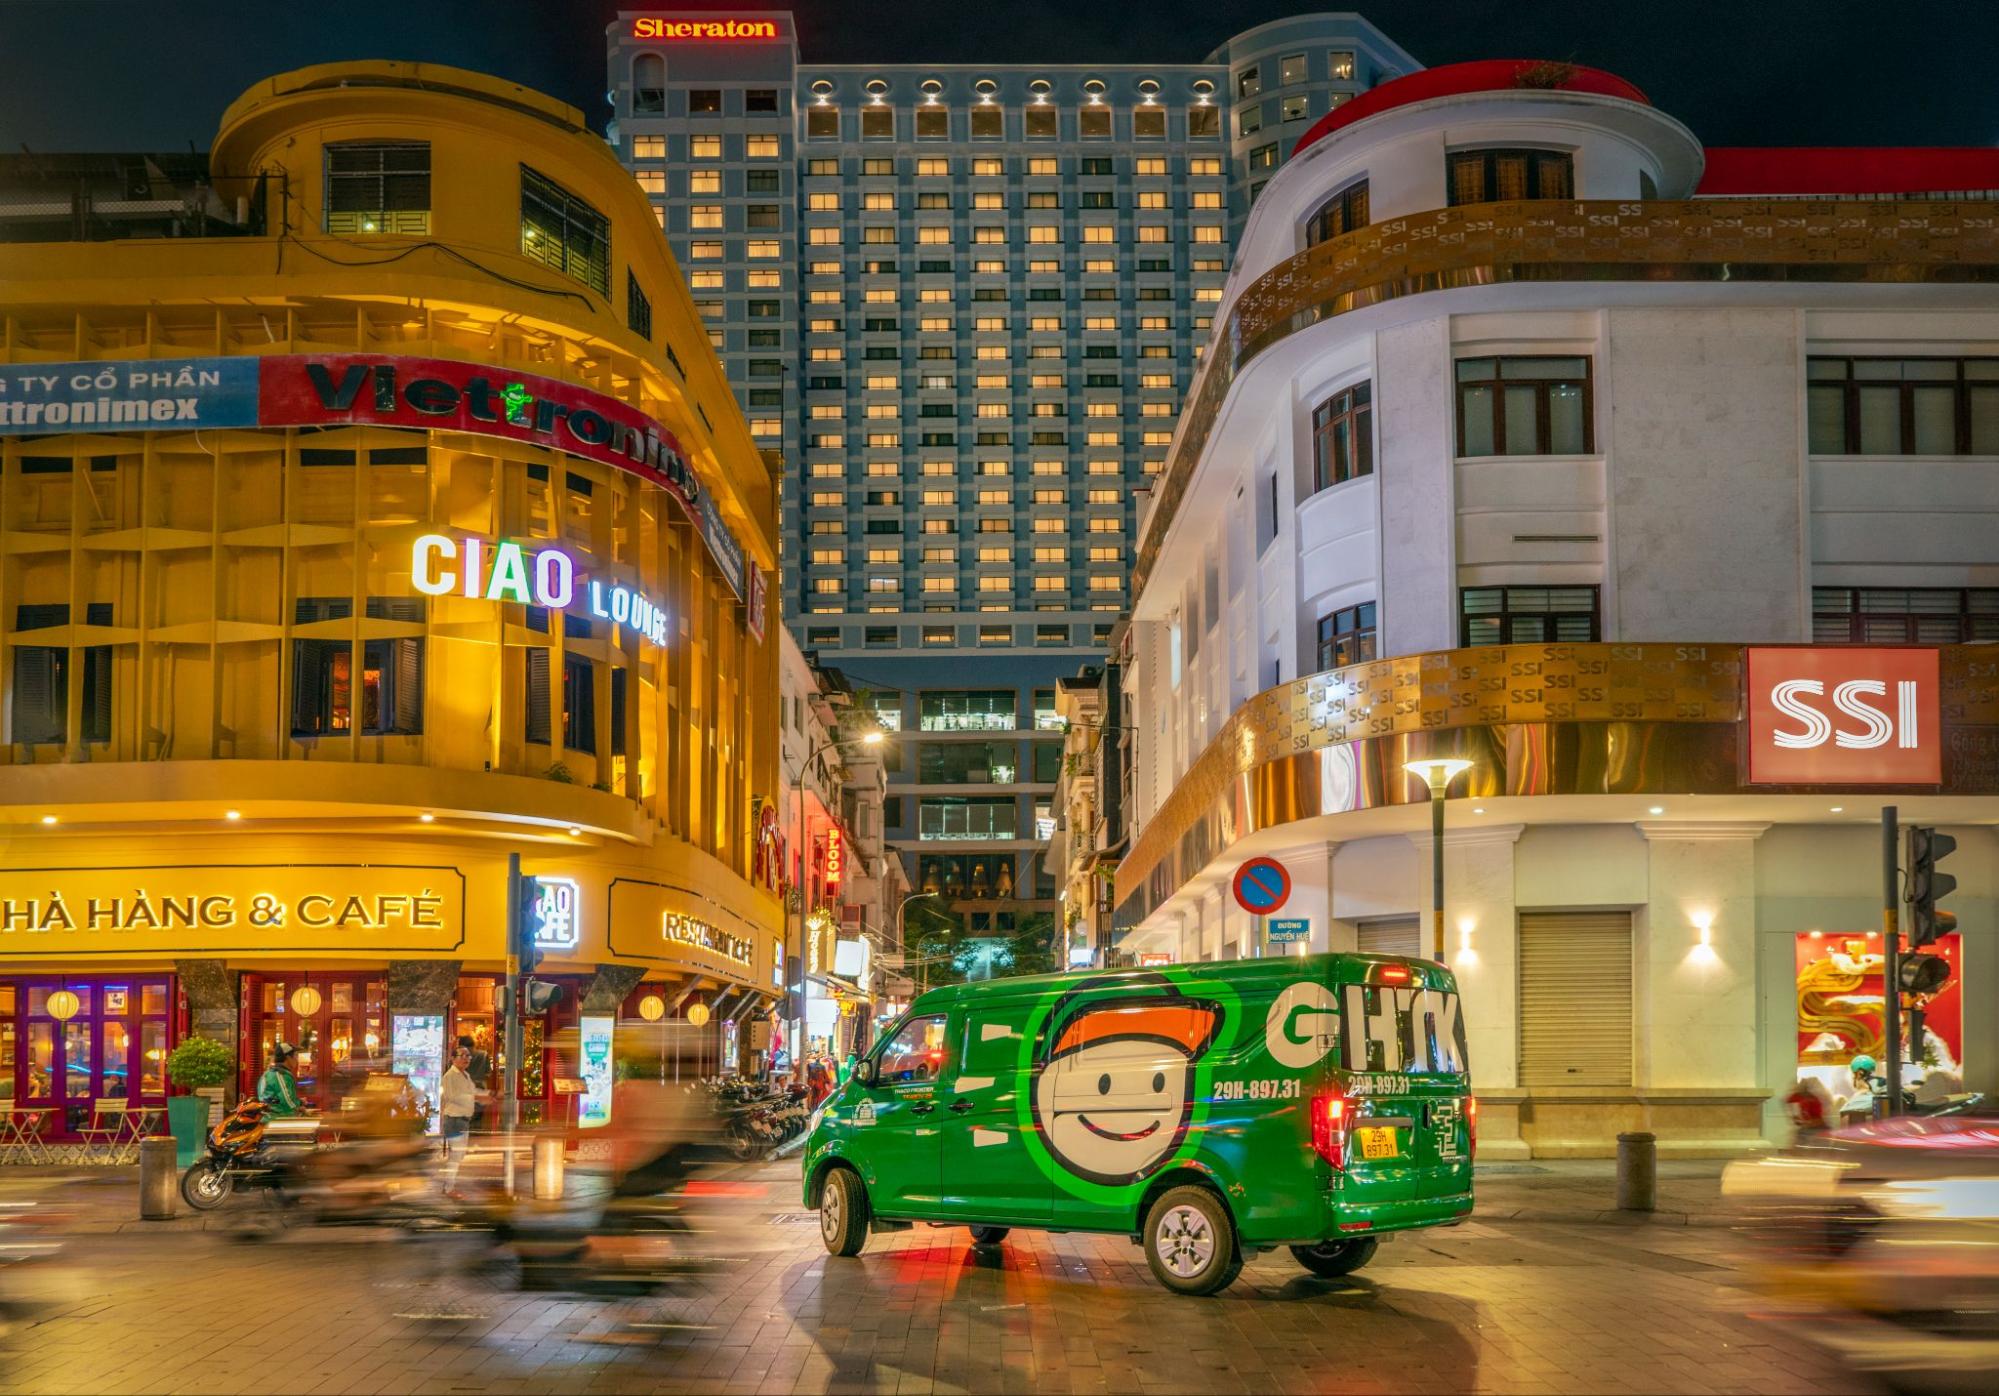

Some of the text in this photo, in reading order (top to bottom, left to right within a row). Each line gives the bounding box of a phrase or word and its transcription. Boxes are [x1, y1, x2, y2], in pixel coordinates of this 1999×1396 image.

[635, 18, 775, 38] Sheraton
[1465, 219, 1494, 232] SSI
[1589, 215, 1618, 227] SSI
[1899, 217, 1929, 228] SSI
[1381, 221, 1407, 237] SSI
[1411, 225, 1438, 240] SSI
[1555, 226, 1584, 238] SSI
[1619, 227, 1649, 238] SSI
[1743, 227, 1772, 238] SSI
[1437, 232, 1465, 246] SSI
[18, 376, 60, 392] TY
[70, 366, 118, 391] CỔ
[129, 365, 221, 388] PHẦN
[412, 534, 573, 608] CIAO
[592, 580, 667, 647] LOUNGE
[1544, 647, 1575, 662] SSI
[1675, 647, 1706, 661] SSI
[1511, 662, 1542, 676] SSI
[1578, 660, 1608, 675] SSI
[1327, 672, 1345, 687] SSI
[1395, 673, 1419, 687] SSI
[1479, 677, 1507, 692] SSI
[1544, 674, 1576, 689] SSI
[1348, 680, 1369, 695] SSI
[1309, 689, 1326, 705] SSI
[1511, 689, 1543, 703] SSI
[1327, 700, 1346, 714] SSI
[1395, 700, 1420, 715] SSI
[1479, 705, 1507, 721] SSI
[1544, 703, 1576, 719] SSI
[1612, 703, 1643, 717] SSI
[1771, 679, 1918, 750] SSI
[1350, 708, 1371, 723] SSI
[1422, 710, 1449, 726] SSI
[1310, 716, 1327, 731] SSI
[1371, 717, 1394, 733] SSI
[1293, 734, 1309, 749] SSI
[1327, 726, 1346, 742] SSI
[826, 829, 842, 883] BLOOM
[87, 889, 234, 931] HÀNG
[248, 892, 286, 928] &
[297, 888, 443, 929] CAFÉ
[534, 912, 570, 940] AFE
[1213, 1079, 1301, 1100] 29H-897.31
[1347, 1076, 1410, 1095] 29H-897.31
[1371, 1130, 1387, 1143] 29H
[1366, 1143, 1394, 1157] 897.31
